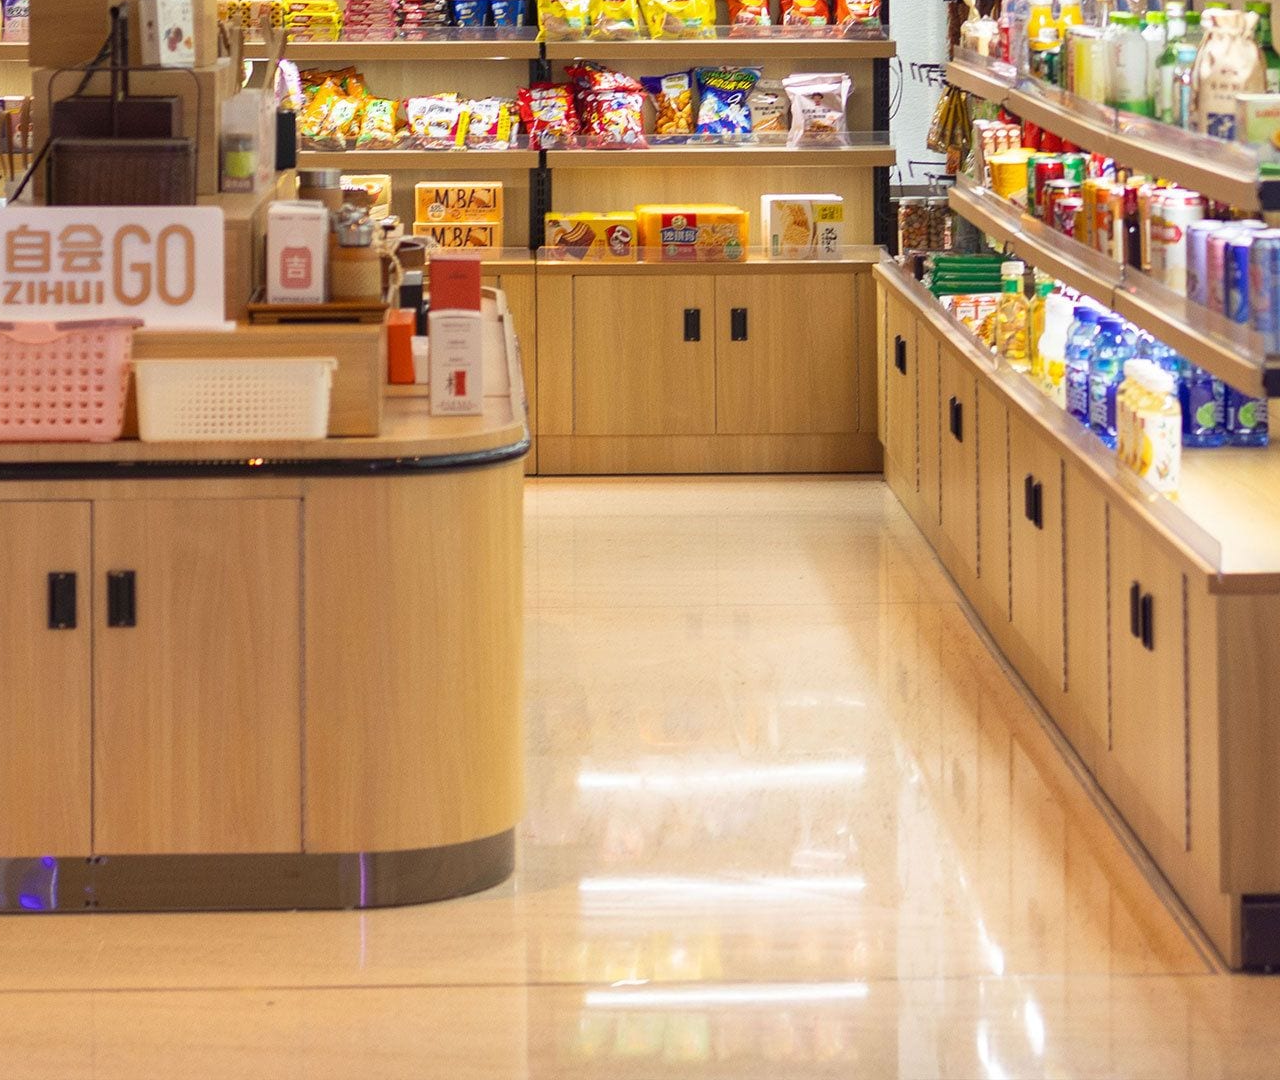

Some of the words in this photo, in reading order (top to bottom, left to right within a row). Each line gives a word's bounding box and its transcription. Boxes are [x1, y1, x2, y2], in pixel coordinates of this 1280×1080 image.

[5, 224, 103, 273] 自会
[113, 224, 195, 306] GO
[2, 280, 104, 305] ZIHUI
